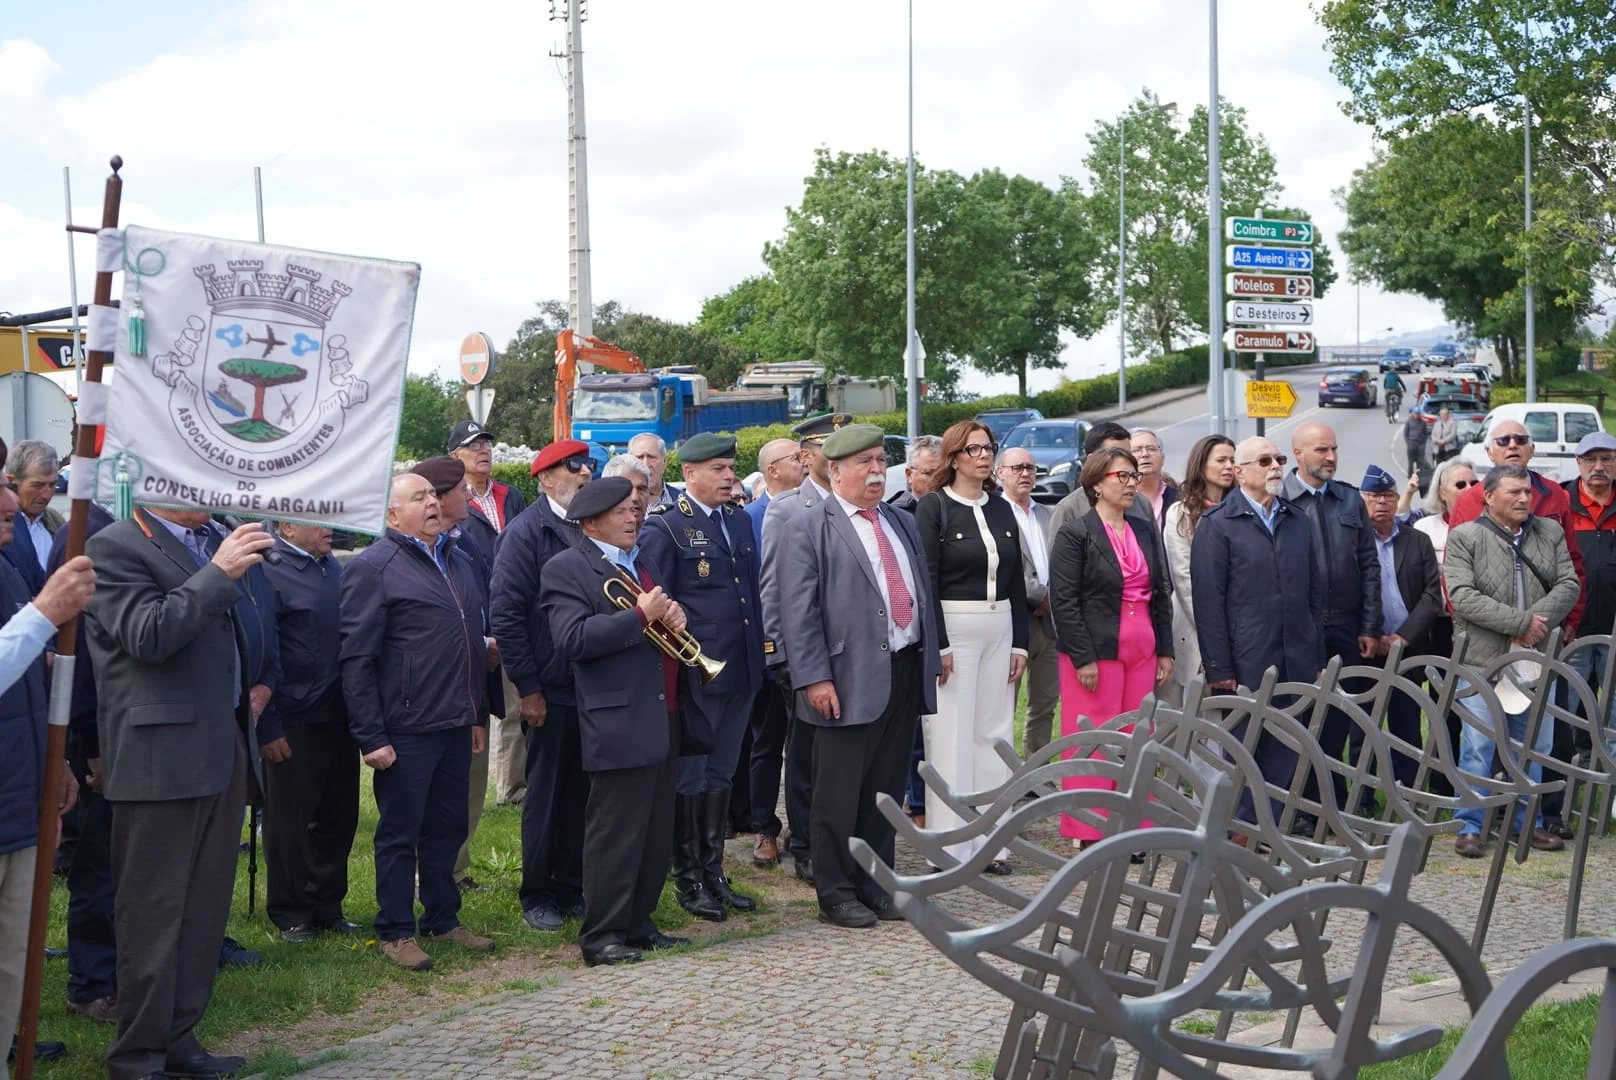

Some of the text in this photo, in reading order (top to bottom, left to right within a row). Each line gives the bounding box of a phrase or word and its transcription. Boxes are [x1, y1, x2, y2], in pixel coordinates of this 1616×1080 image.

[1234, 222, 1297, 237] Coimbra IP3
[1234, 250, 1284, 264] A25 Aveiro
[1234, 278, 1275, 292] Molelos
[1235, 306, 1297, 320] C. Besteiros
[1235, 333, 1284, 347] Caramulo
[1252, 382, 1281, 392] Desvio
[177, 407, 334, 471] ASSOCIAÇÃO DE COMBATENTES
[144, 476, 232, 507] CONCELHO
[239, 494, 261, 509] DE
[237, 480, 256, 491] DO
